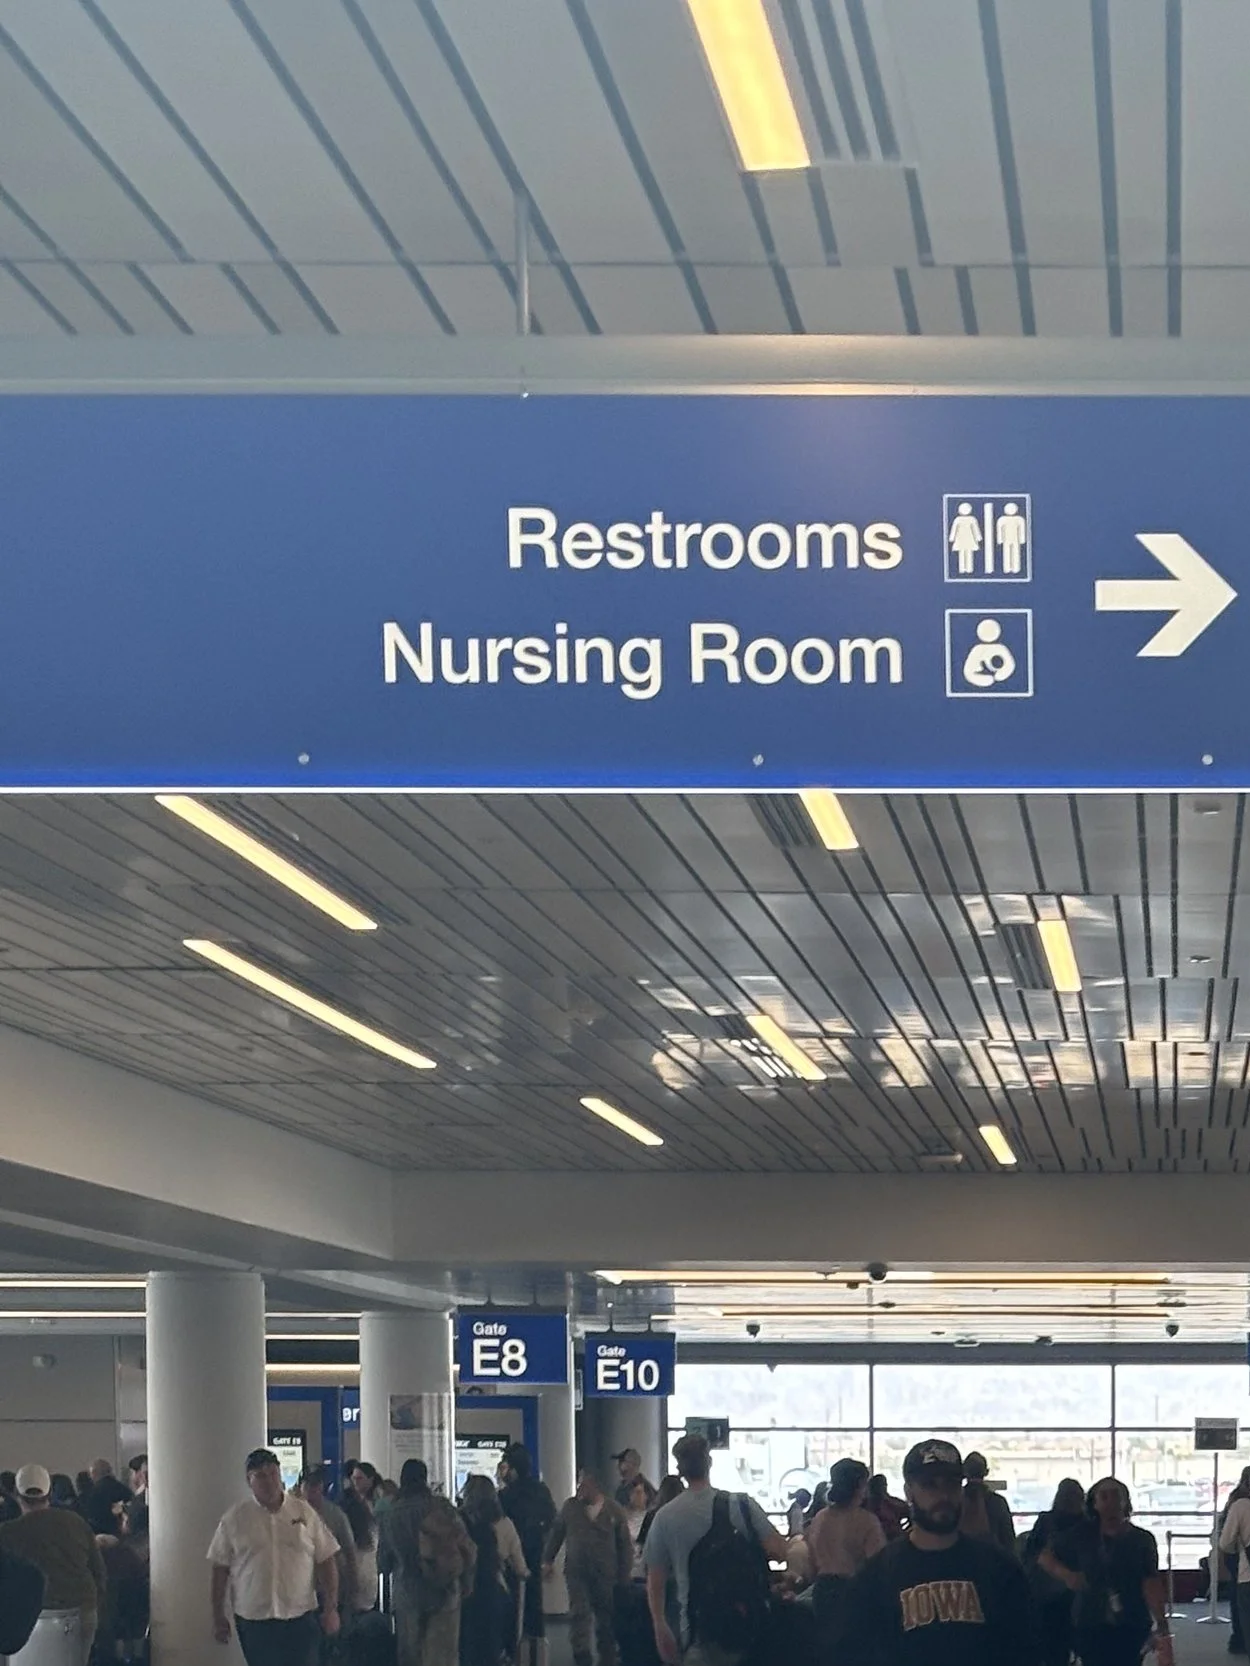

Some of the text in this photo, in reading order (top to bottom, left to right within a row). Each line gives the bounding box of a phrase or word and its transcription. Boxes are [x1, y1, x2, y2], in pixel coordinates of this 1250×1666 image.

[508, 507, 903, 569] Restrooms
[383, 622, 903, 700] Nursing Room
[472, 1321, 508, 1336] Gate
[472, 1338, 529, 1377] E8
[597, 1344, 627, 1358] Gate
[596, 1358, 661, 1392] E10
[900, 1580, 984, 1631] IOWA
